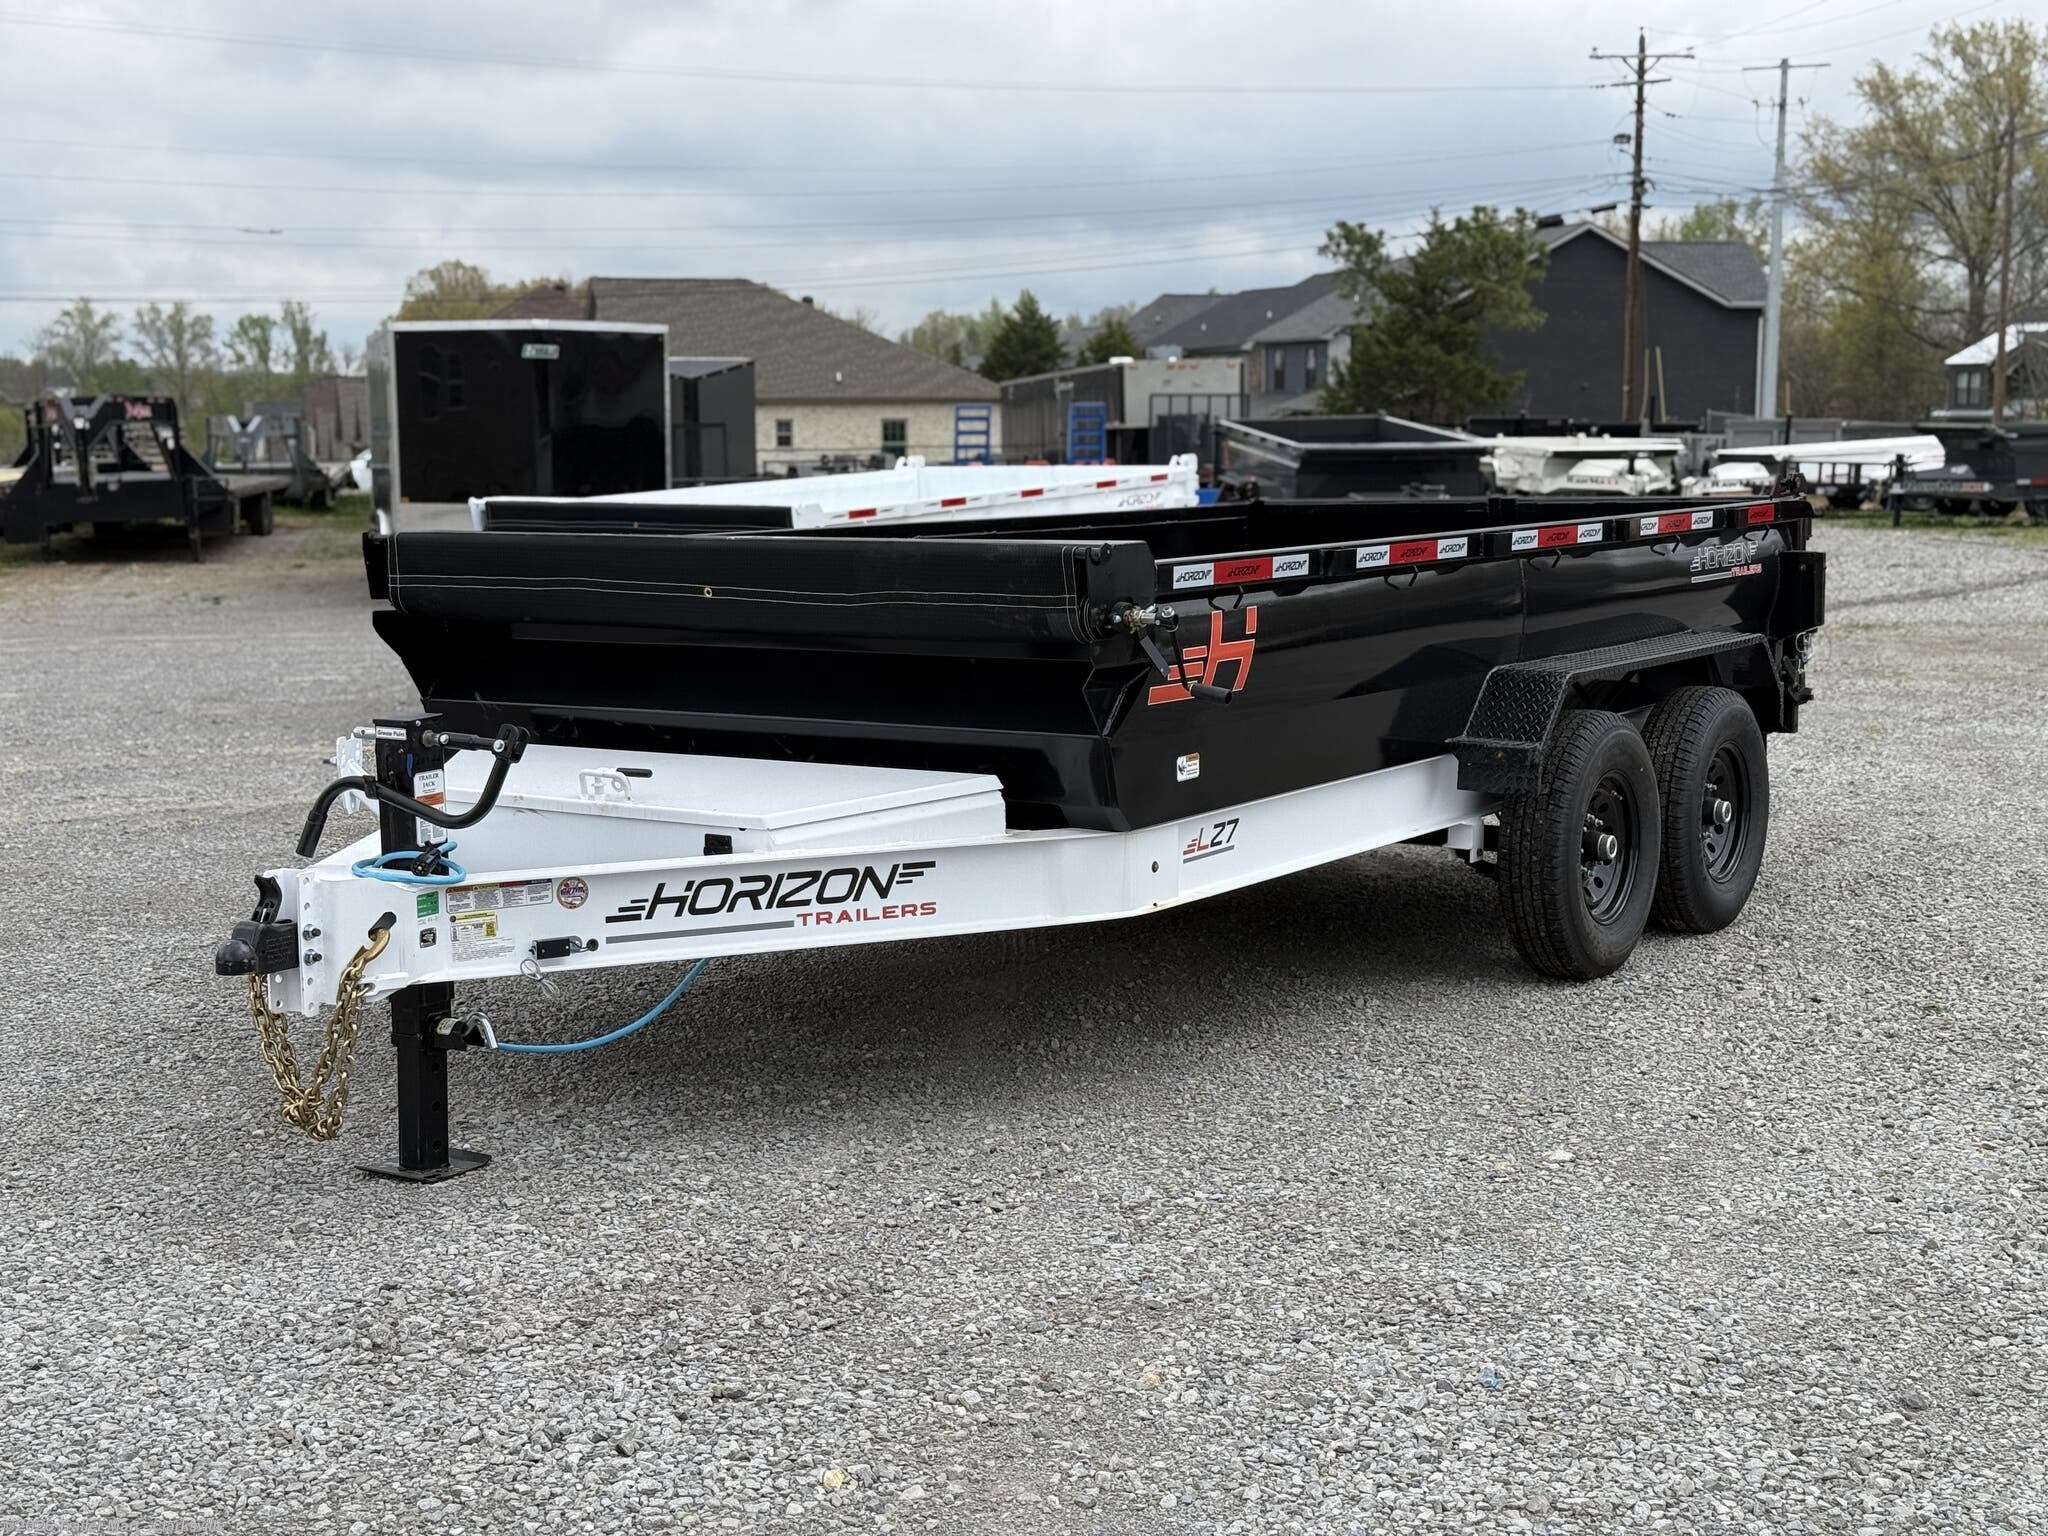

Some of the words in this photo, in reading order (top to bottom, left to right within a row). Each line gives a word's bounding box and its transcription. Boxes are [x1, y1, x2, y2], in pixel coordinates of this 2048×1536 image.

[1359, 550, 1388, 563] HORIZON
[1400, 546, 1428, 559] HORIZON
[1439, 542, 1466, 555] HORIZON
[1696, 541, 1753, 570] HORIZON
[1175, 569, 1212, 583] HORIZON
[1226, 564, 1260, 578] HORIZON
[1274, 559, 1307, 573] HORIZON
[1731, 563, 1762, 577] TRAILERS
[418, 772, 439, 781] TRAILER
[423, 781, 436, 789] JACK
[1195, 818, 1240, 852] L27
[643, 862, 903, 920] HORIZON
[796, 901, 937, 927] TRAILERS
